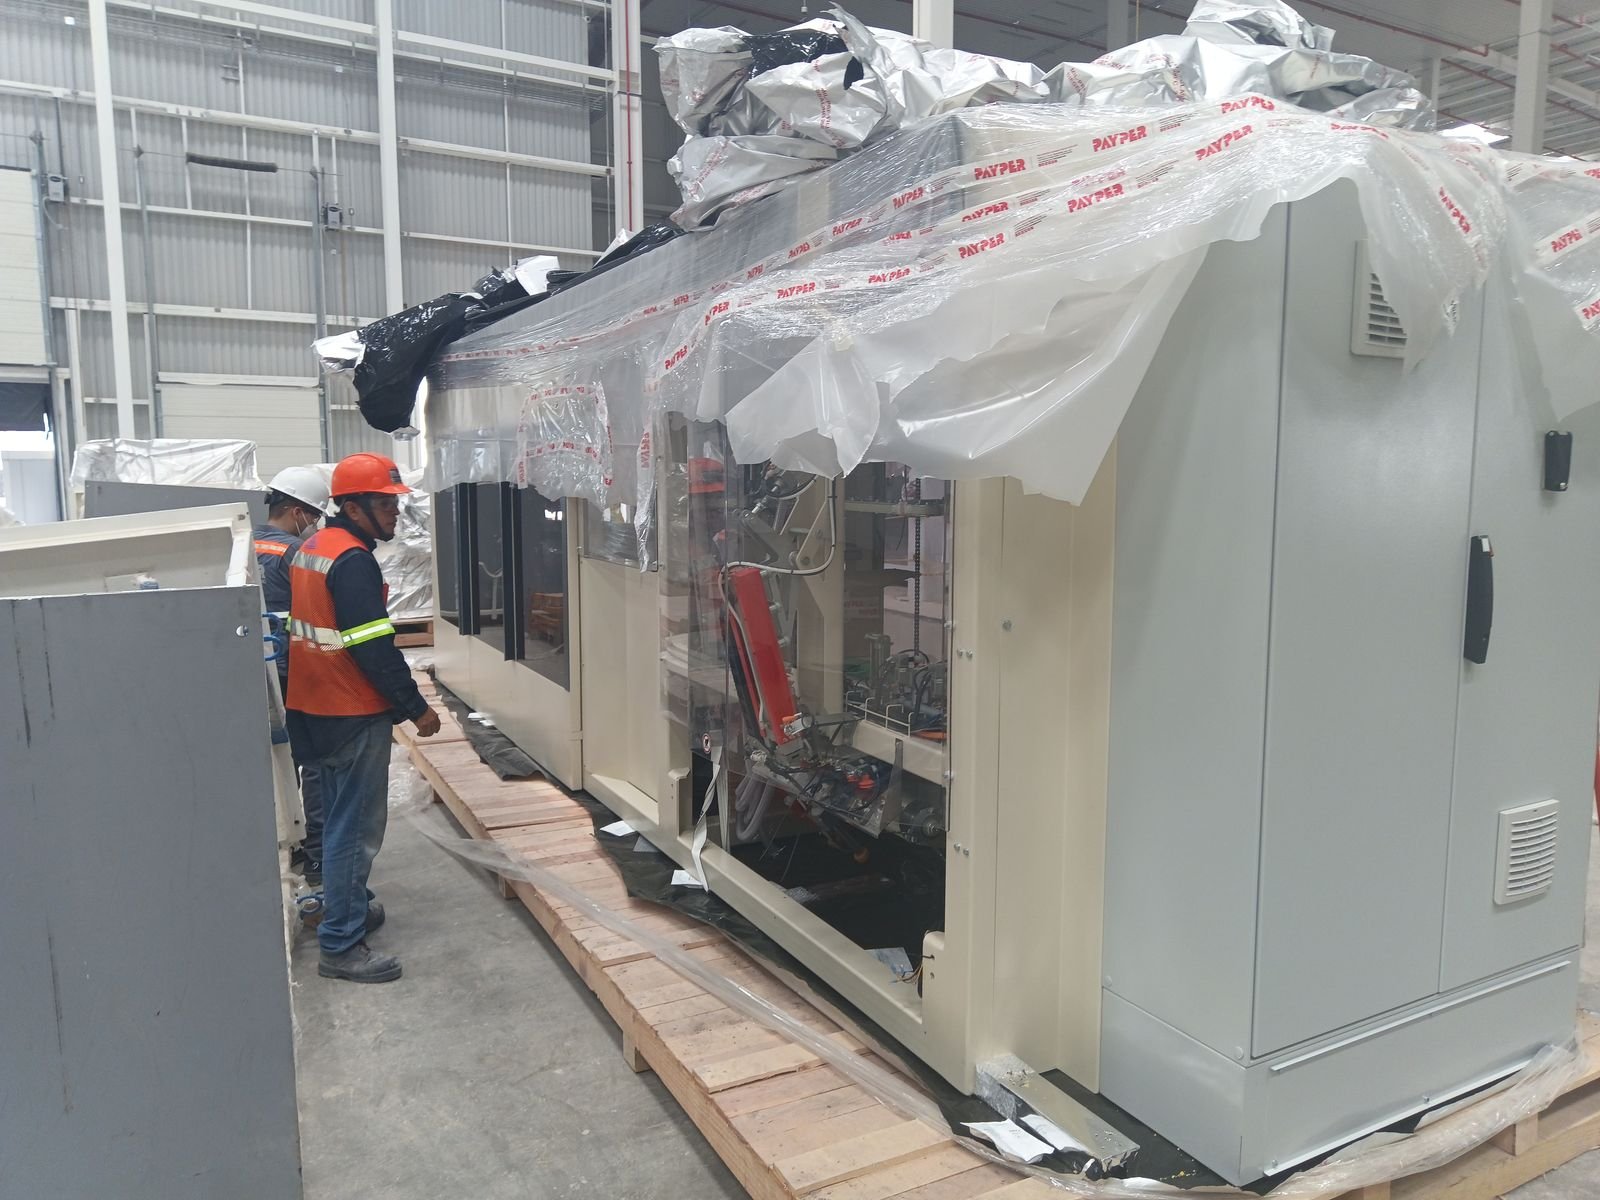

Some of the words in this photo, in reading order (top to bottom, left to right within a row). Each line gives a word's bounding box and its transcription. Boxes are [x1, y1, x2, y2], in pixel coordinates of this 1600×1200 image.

[1092, 125, 1148, 152] PAYPER
[1195, 125, 1253, 161] PAYPER
[974, 158, 1026, 180] PAYPER
[1067, 183, 1124, 213] PAYPER
[958, 232, 1005, 259] PAYPER
[868, 267, 911, 284] PAYPER
[777, 282, 816, 299] PAYPER
